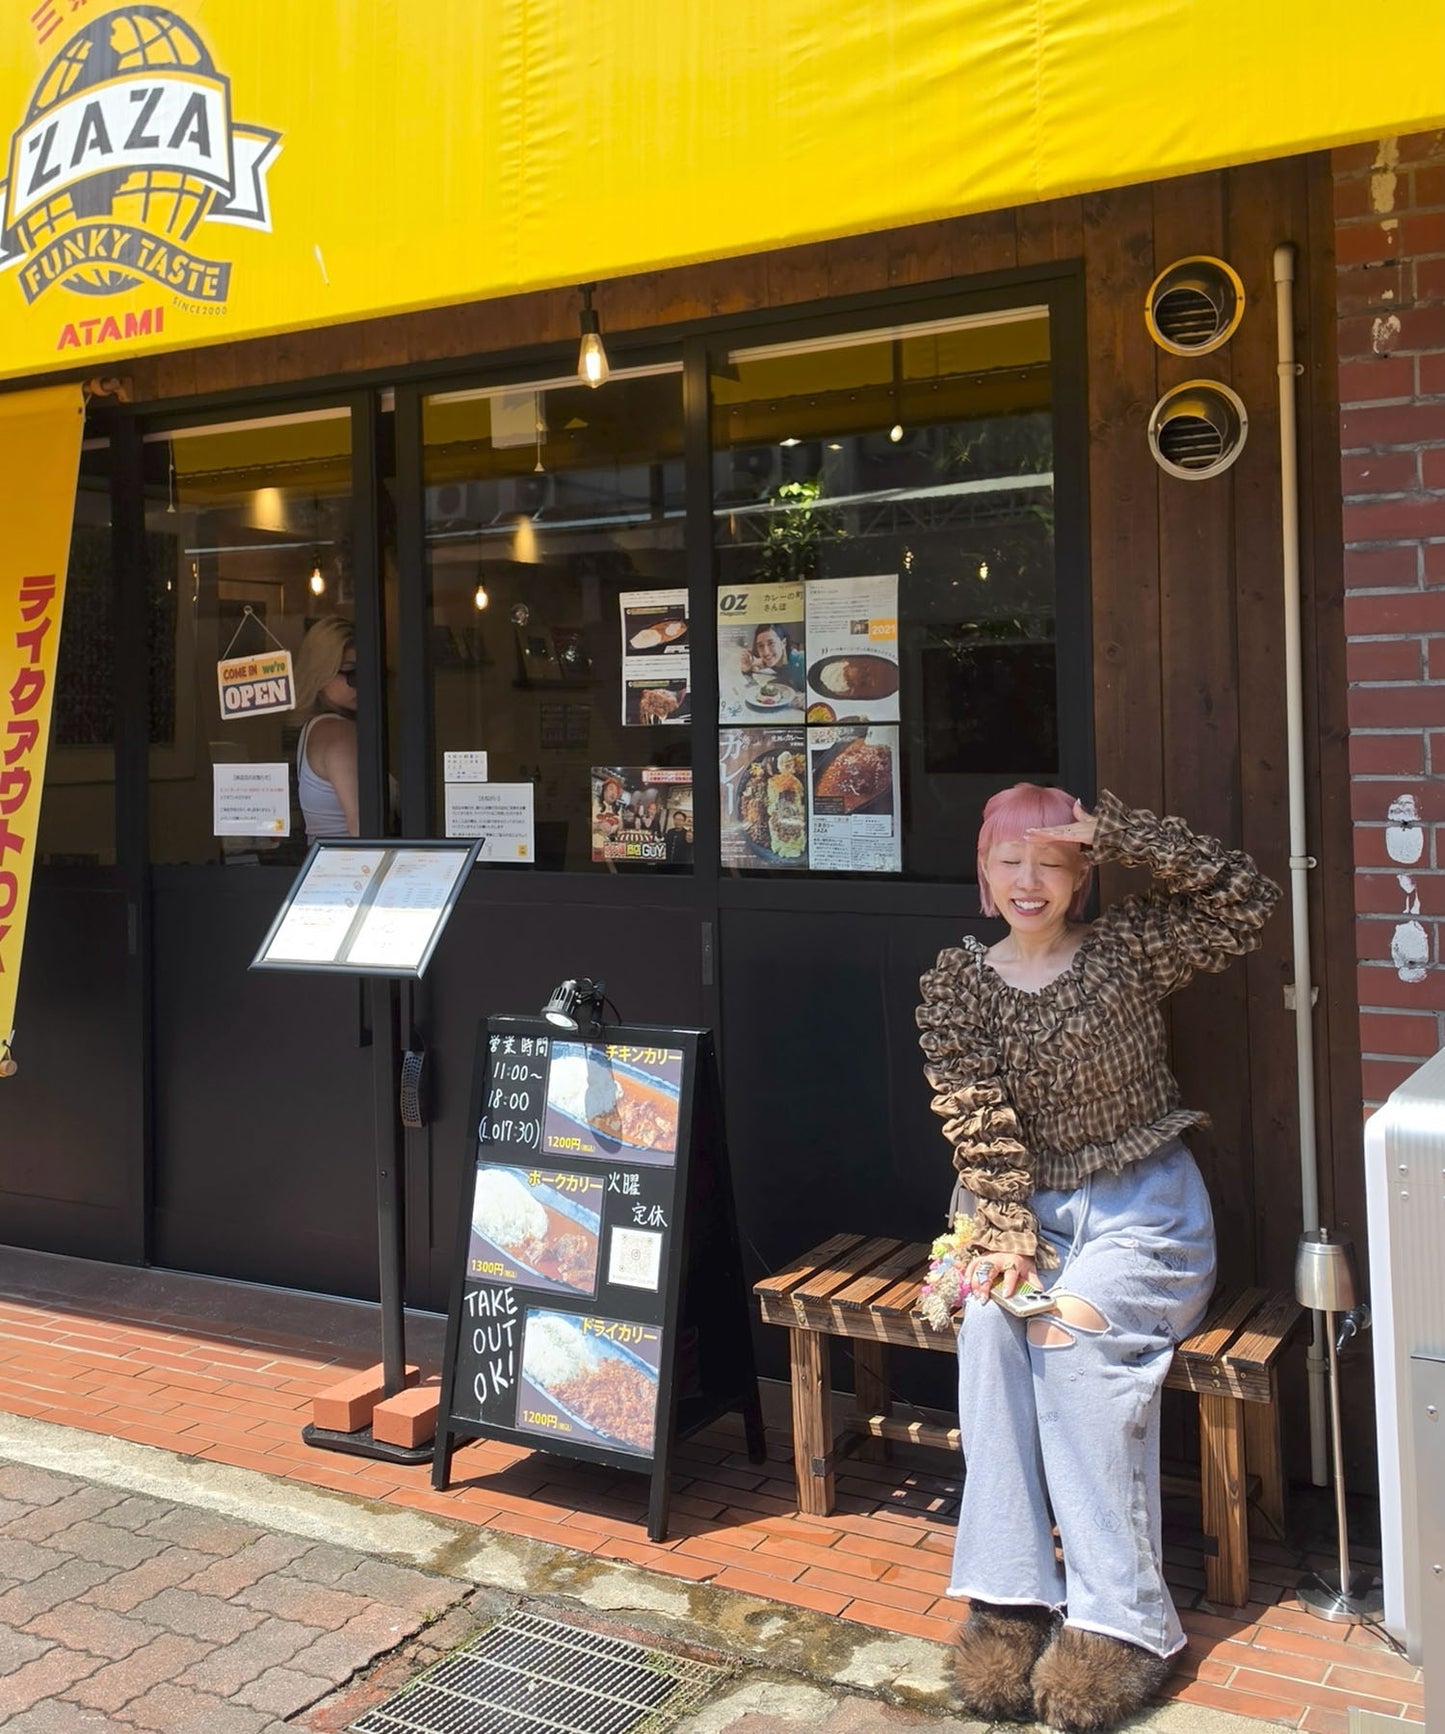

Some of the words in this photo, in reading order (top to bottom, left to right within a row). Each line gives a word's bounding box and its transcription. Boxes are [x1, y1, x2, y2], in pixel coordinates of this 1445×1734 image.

[27, 87, 212, 197] ZAZA
[22, 228, 131, 296] FUNKY
[139, 239, 220, 297] TASTE
[57, 307, 165, 351] ATAMI
[720, 594, 748, 611] OZ
[223, 666, 247, 680] COME
[248, 664, 258, 676] IN
[225, 679, 287, 710] OPEN
[489, 1035, 549, 1057] 営業時間
[605, 1045, 683, 1064] チキンカリー
[488, 1089, 530, 1111] 18:00
[547, 1136, 581, 1151] 1200円
[608, 1171, 641, 1196] 火曜
[632, 1202, 669, 1228] 定休
[471, 1259, 504, 1277] 1300円
[464, 1287, 518, 1317] TAKE
[473, 1319, 517, 1354] OUT
[582, 1317, 658, 1344] ドライカリー
[523, 1410, 558, 1429] 1200円
